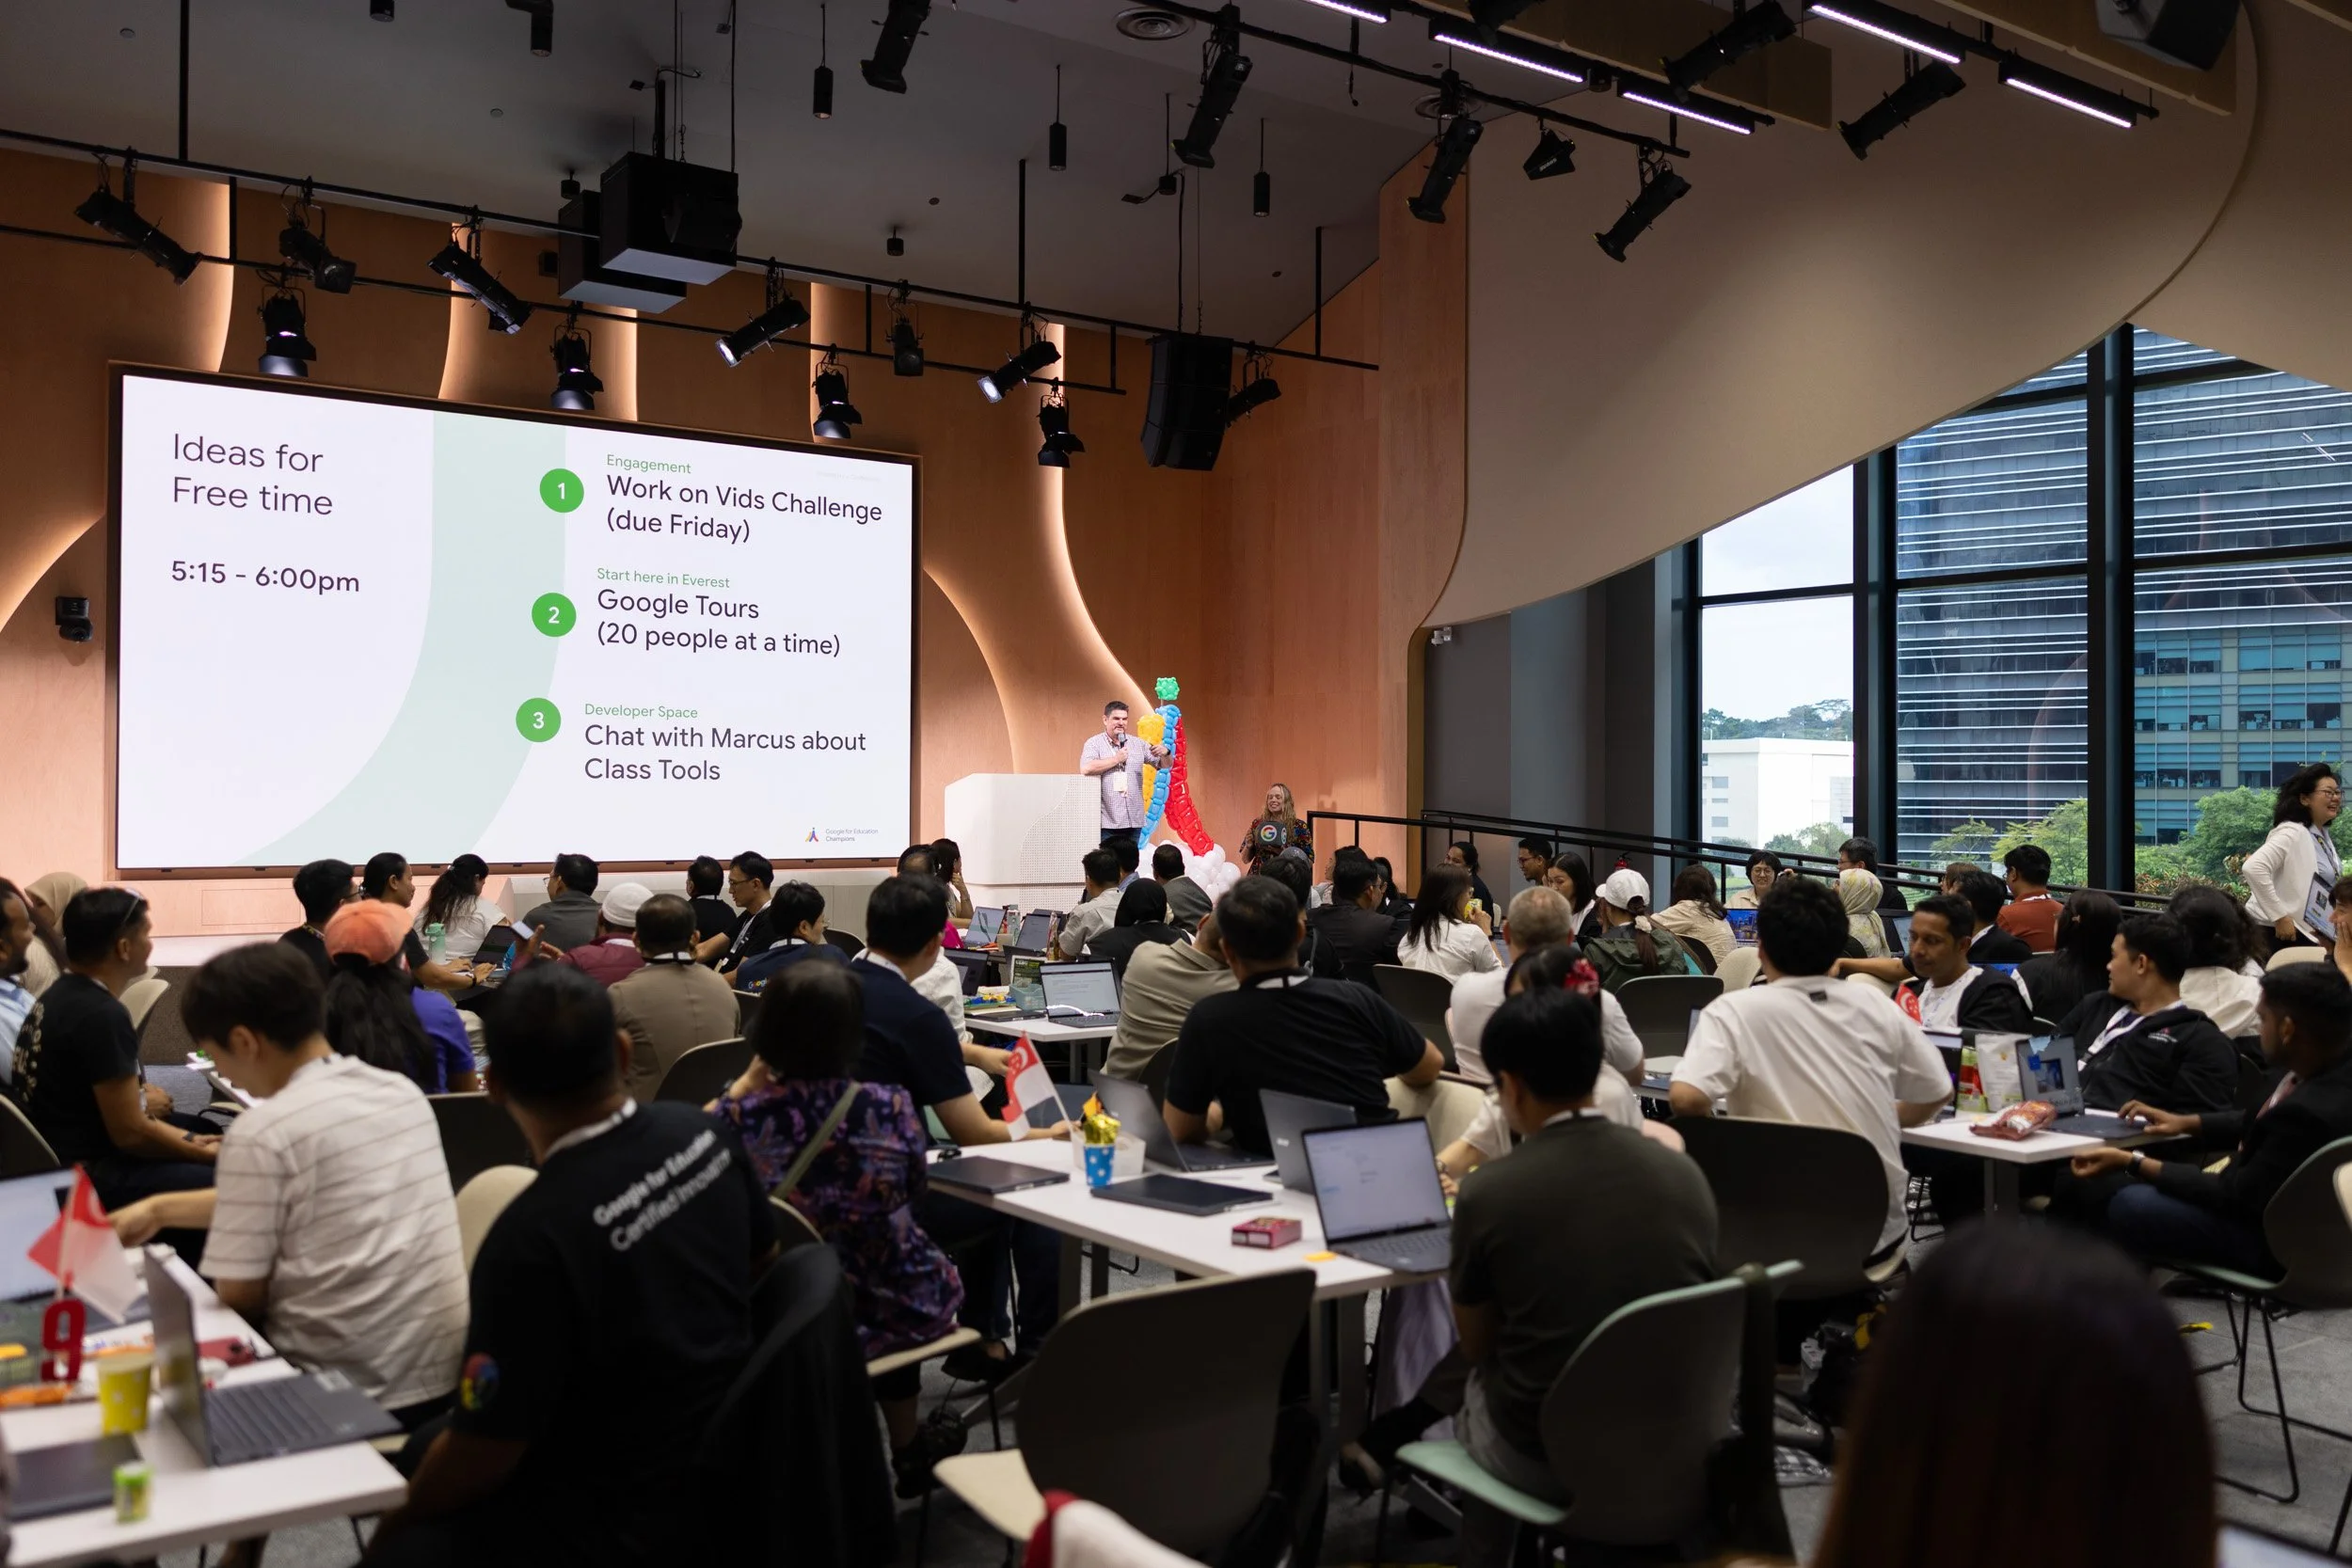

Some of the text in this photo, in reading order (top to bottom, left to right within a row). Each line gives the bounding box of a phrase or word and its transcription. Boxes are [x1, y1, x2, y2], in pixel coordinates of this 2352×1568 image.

[174, 433, 324, 473] Ideas for
[607, 453, 691, 475] Engagement
[173, 477, 333, 515] Free time
[557, 482, 565, 500] 1
[607, 474, 882, 526] Work on Vids Challenge
[607, 507, 750, 546] (due Friday)
[172, 560, 227, 584] 5:15
[255, 565, 360, 595] 6:00pm
[596, 567, 730, 589] Start here in Everest
[548, 607, 560, 625] 2
[597, 588, 759, 621] Google Tours
[597, 620, 840, 658] (20 people at a time)
[532, 711, 545, 730] 3
[584, 703, 698, 721] Developer Space
[584, 723, 866, 752] Chat with Marcus about
[584, 757, 721, 781] Class Tools
[593, 1181, 650, 1227] Google
[644, 1167, 669, 1191] for
[610, 1191, 680, 1251] Certified
